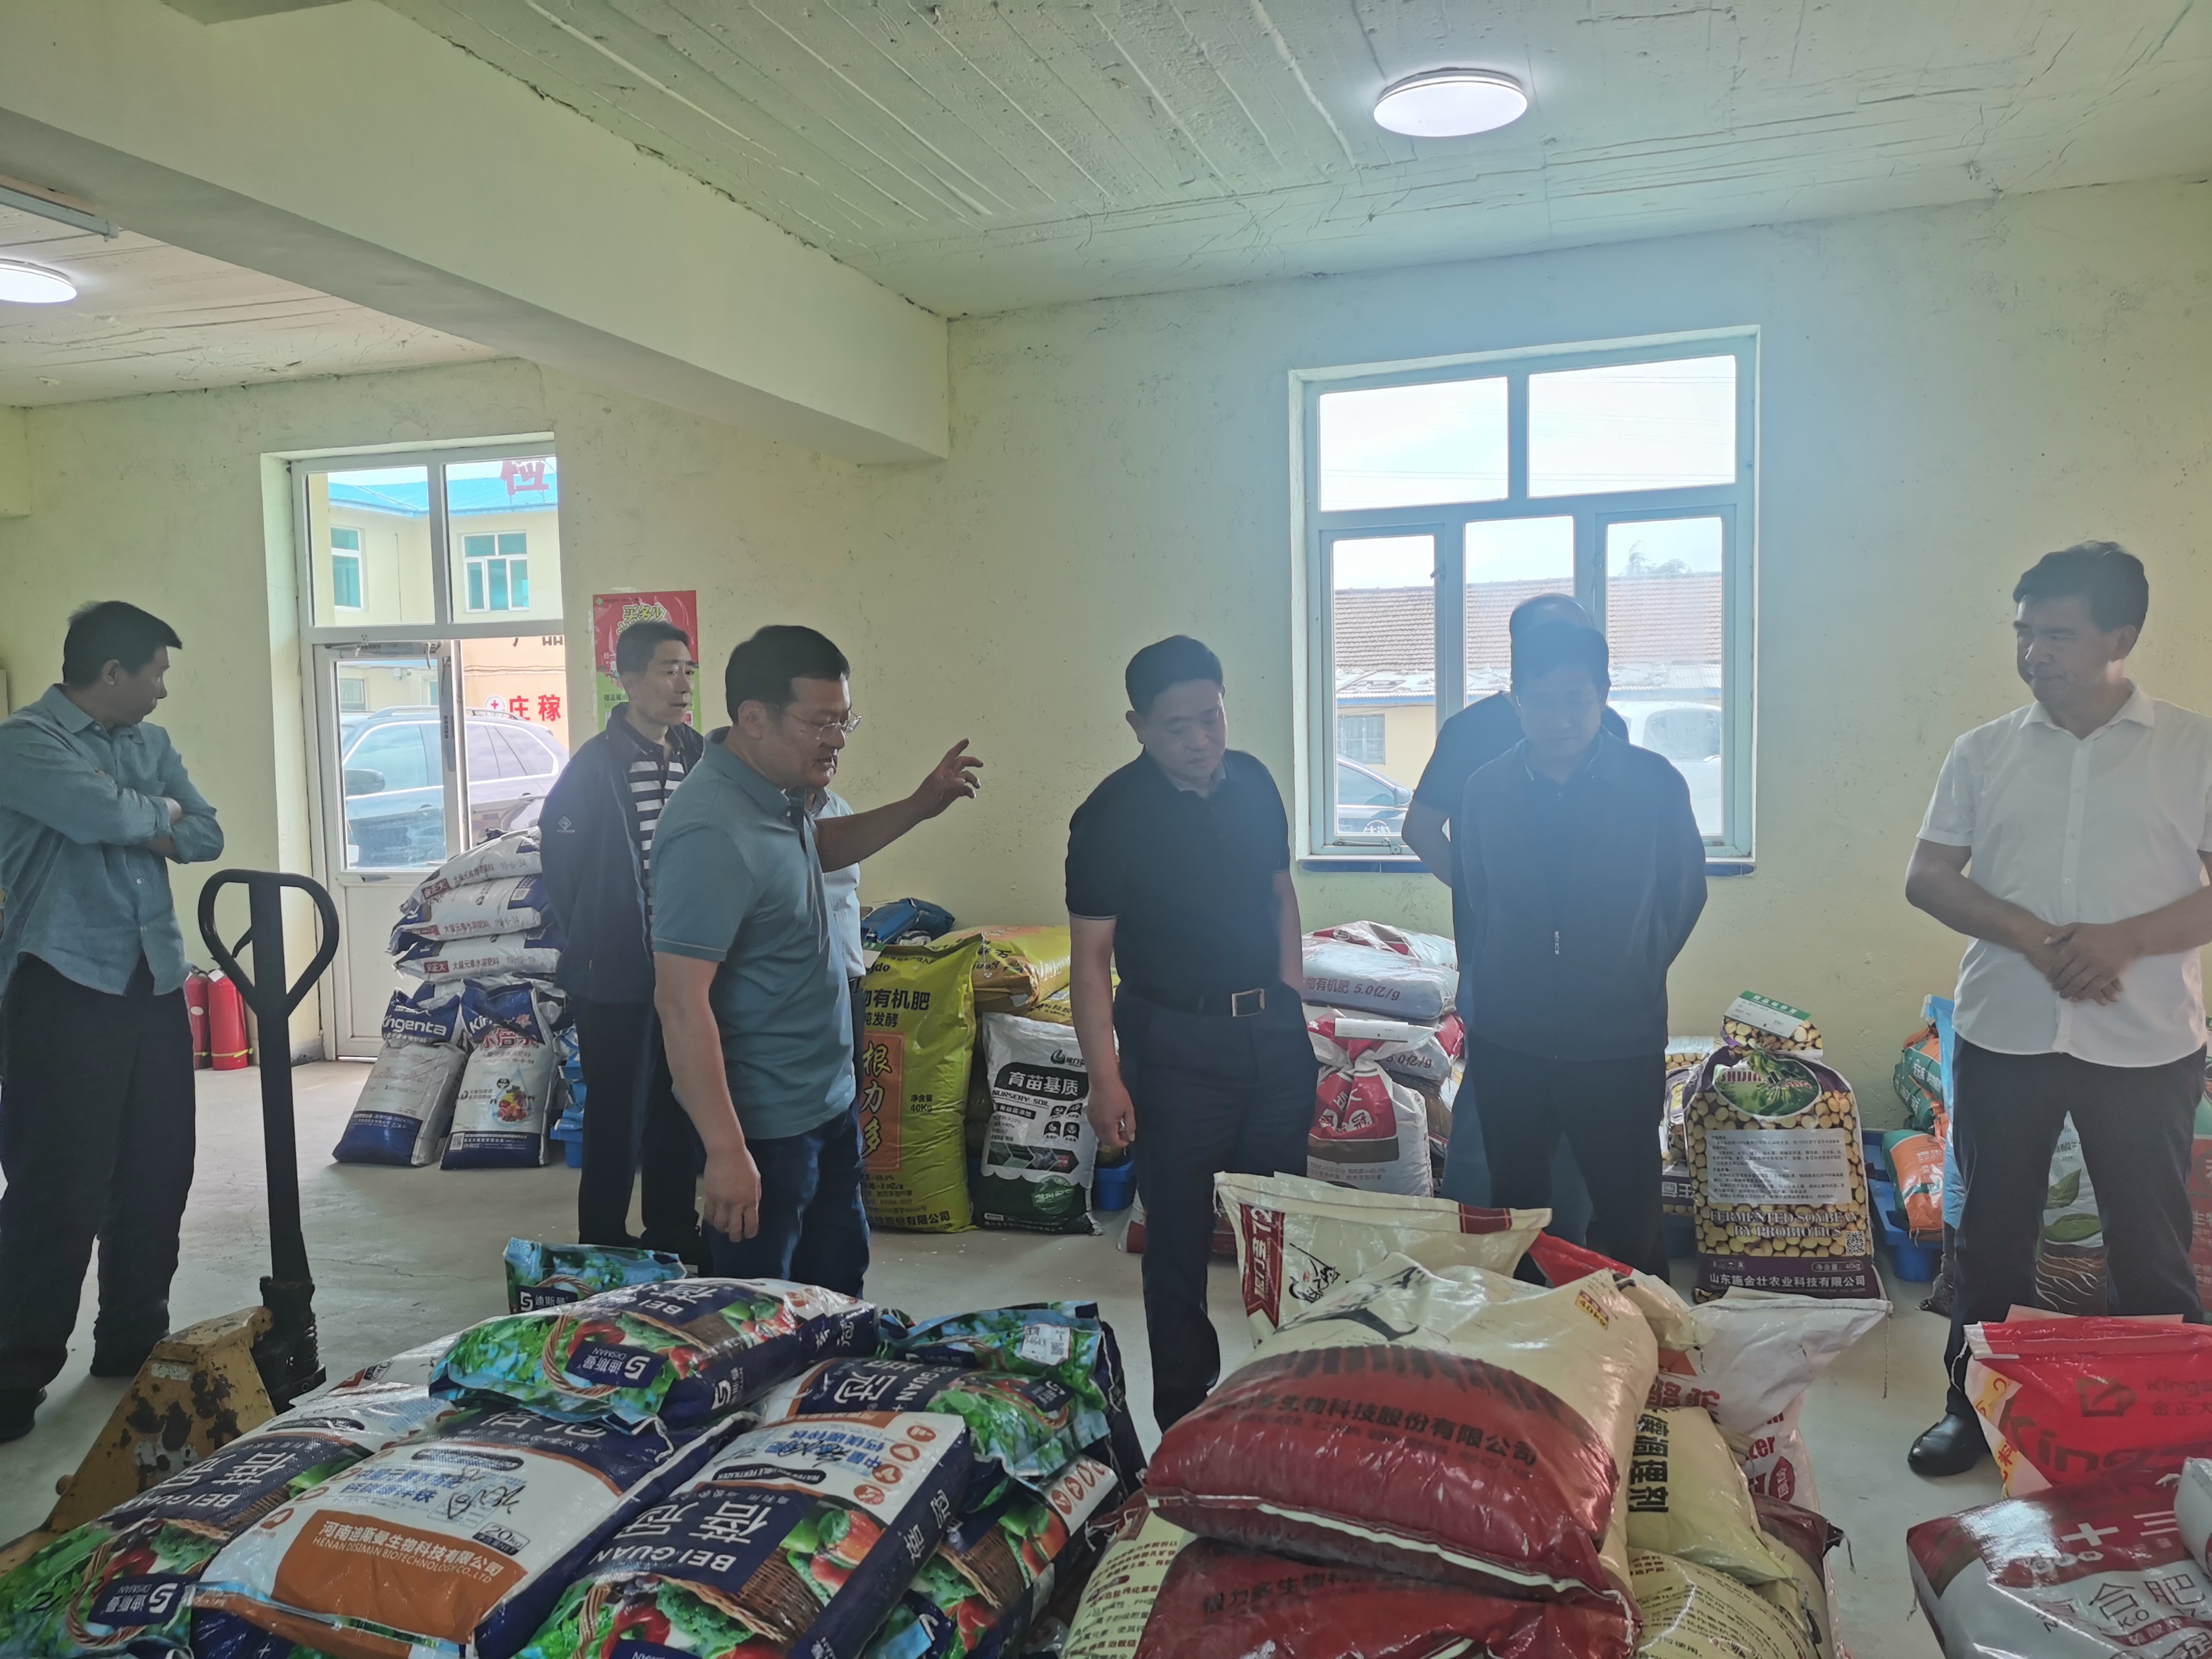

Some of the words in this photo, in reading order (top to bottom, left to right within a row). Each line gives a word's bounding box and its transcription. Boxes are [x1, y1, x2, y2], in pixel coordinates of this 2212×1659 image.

[509, 694, 561, 722] 庄稼
[1303, 977, 1350, 994] 物有机肥
[1353, 984, 1401, 1001] 5.0亿/g
[383, 1016, 447, 1036] Kingenta
[1008, 1071, 1079, 1096] 育苗基质
[859, 1040, 893, 1159] 根力多
[910, 1094, 933, 1102] 净含量
[991, 1089, 1030, 1102] NURSERY
[1033, 1098, 1050, 1107] SOIL
[910, 1104, 933, 1113] 40Kg
[1710, 1212, 1794, 1224] FERMENTED
[1734, 1225, 1753, 1238] BY
[1757, 1225, 1843, 1238] PROBIOTICS
[1709, 1273, 1866, 1287] 山东施金壮农业科技有限公司
[534, 1294, 566, 1306] 迪斯曼
[638, 1299, 685, 1315] BEI
[591, 1347, 628, 1360] DISMAN
[583, 1354, 623, 1375] 迪斯曼
[1218, 1393, 1538, 1467] 力多生物科技股份有限公司
[1628, 1408, 1669, 1513] 壤调理剂
[187, 1493, 243, 1507] BEI
[486, 1524, 525, 1550] 20kg
[312, 1535, 347, 1552] HENAN
[382, 1548, 457, 1573] BIOTECHNOLOGY
[318, 1520, 504, 1577] 河南迪斯曼生物科技有限公司
[588, 1546, 675, 1566] GUAN
[677, 1548, 737, 1572] BEI
[104, 1594, 147, 1613] 迪斯曼
